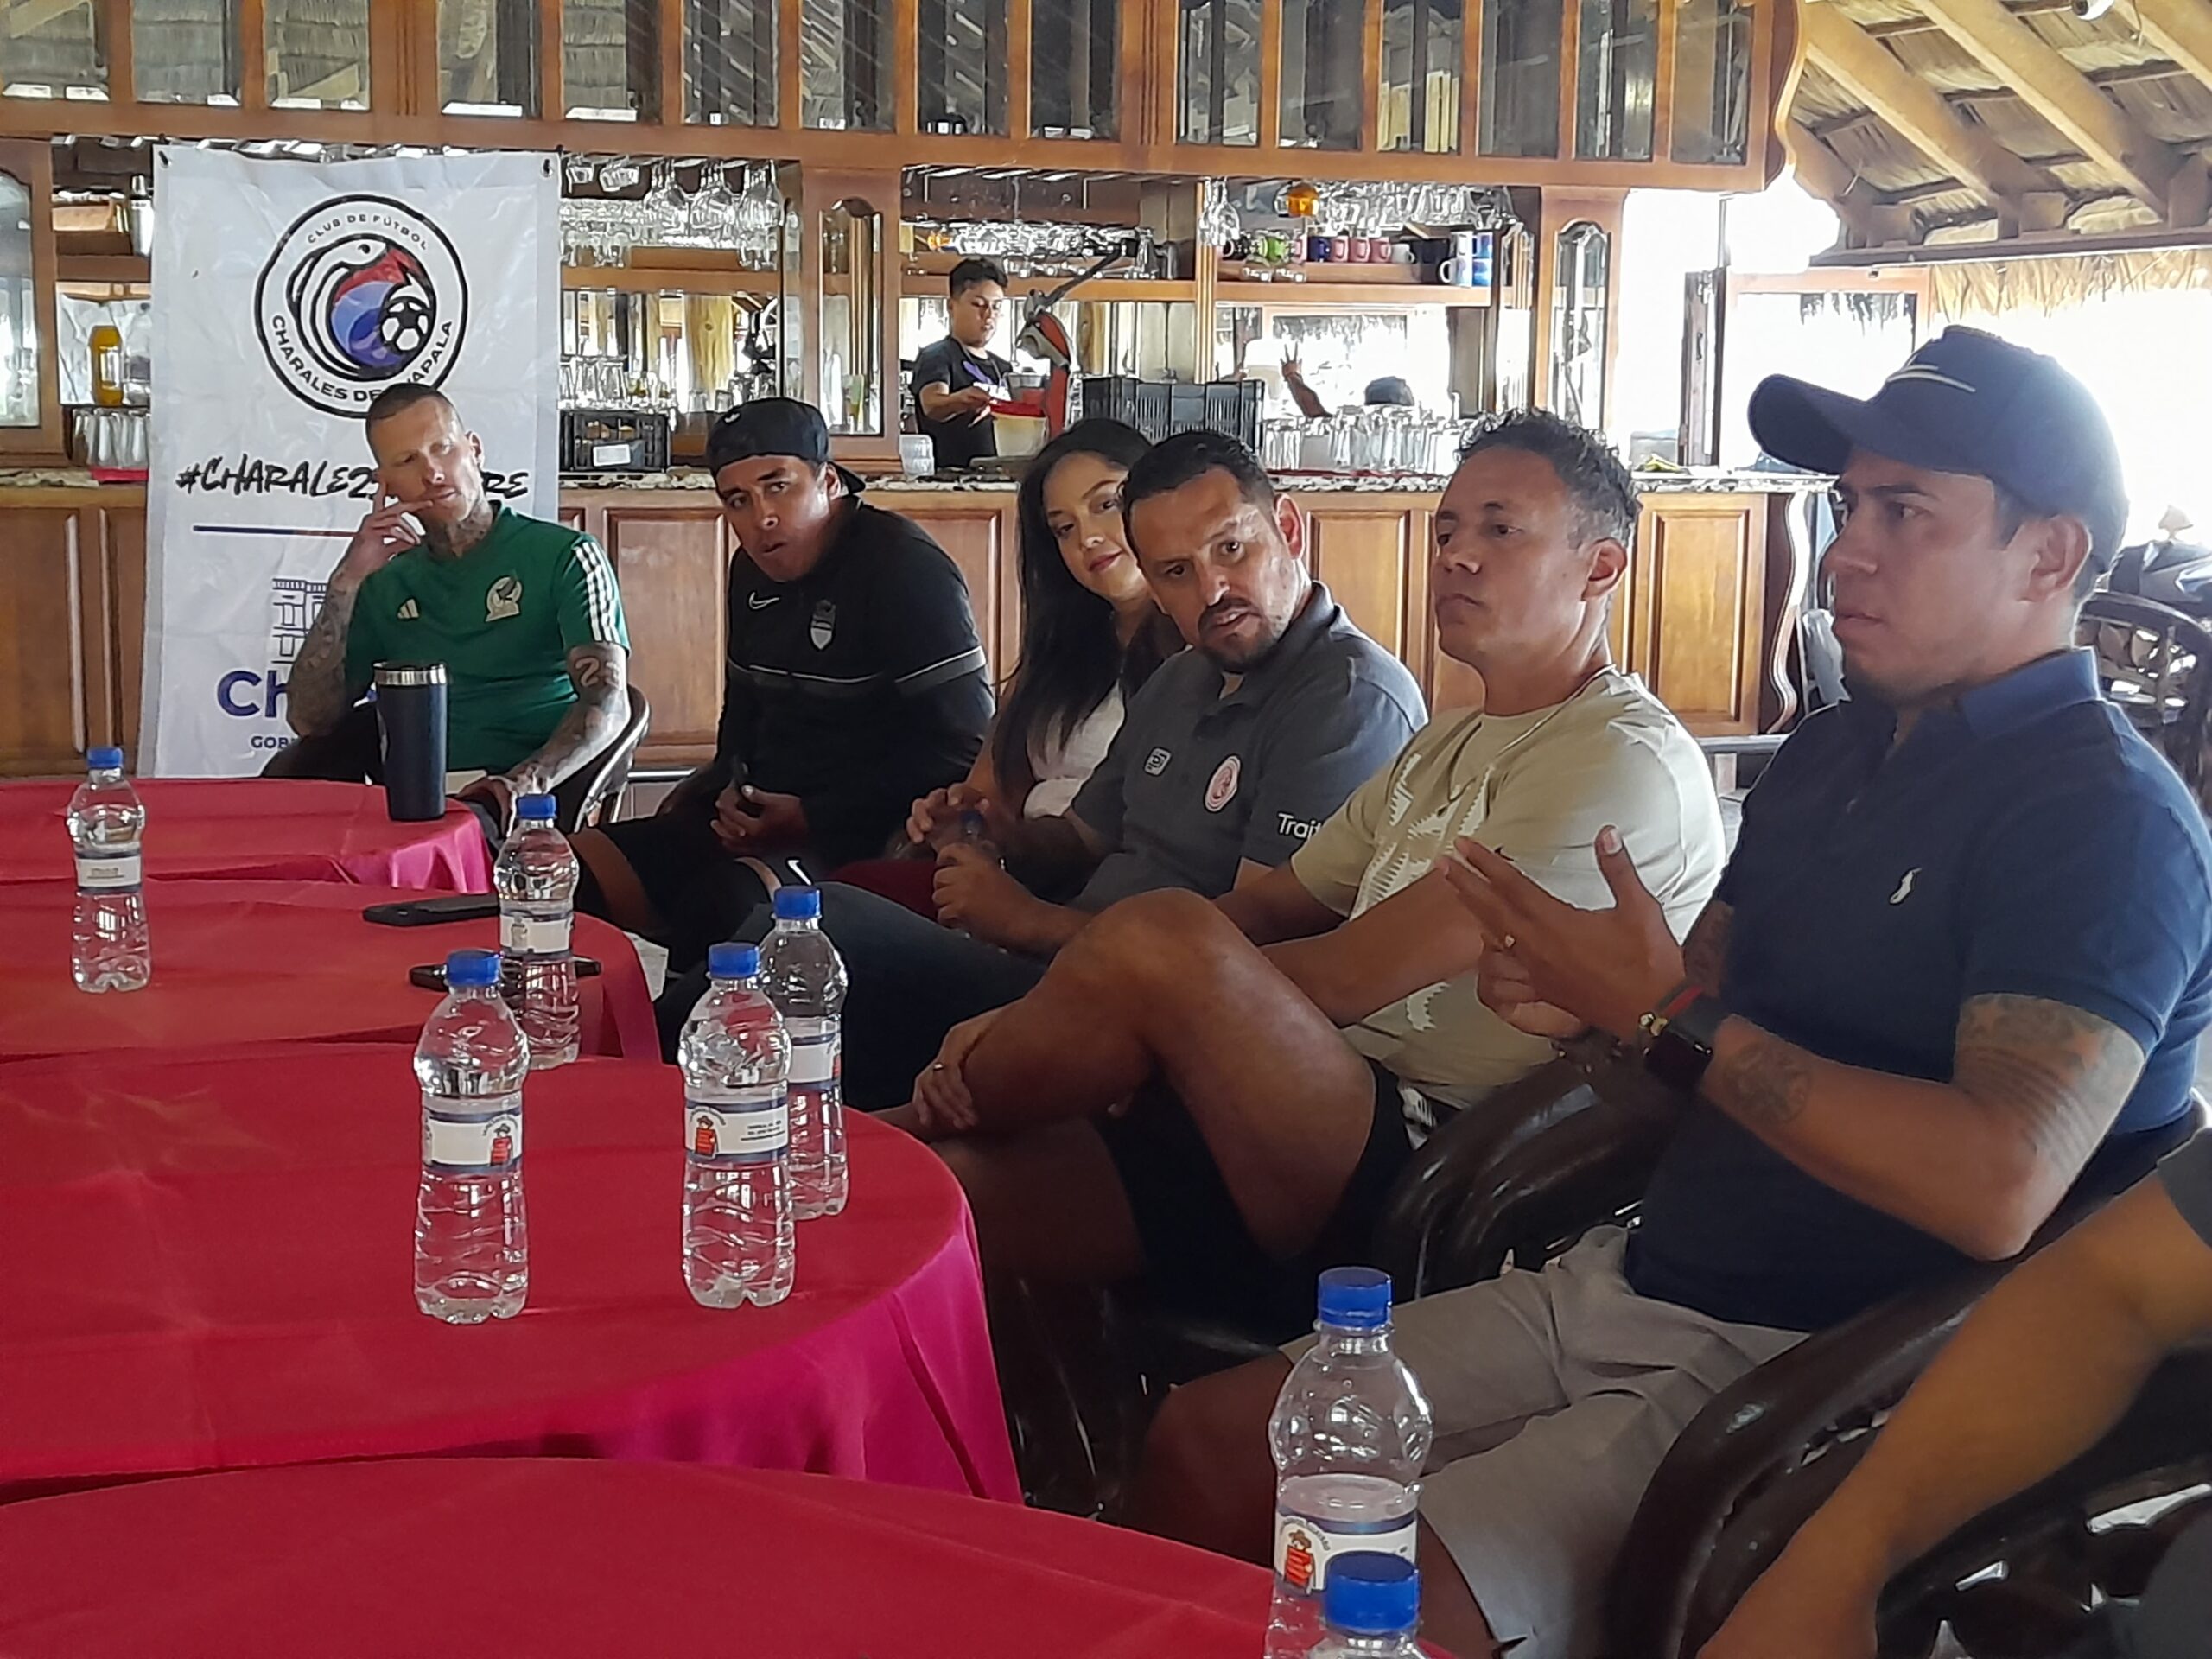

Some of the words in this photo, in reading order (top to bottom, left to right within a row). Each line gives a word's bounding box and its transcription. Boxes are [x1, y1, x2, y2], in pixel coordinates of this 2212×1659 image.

[308, 219, 340, 244] CLUB
[347, 214, 366, 223] DE
[272, 315, 348, 399] CHARALES
